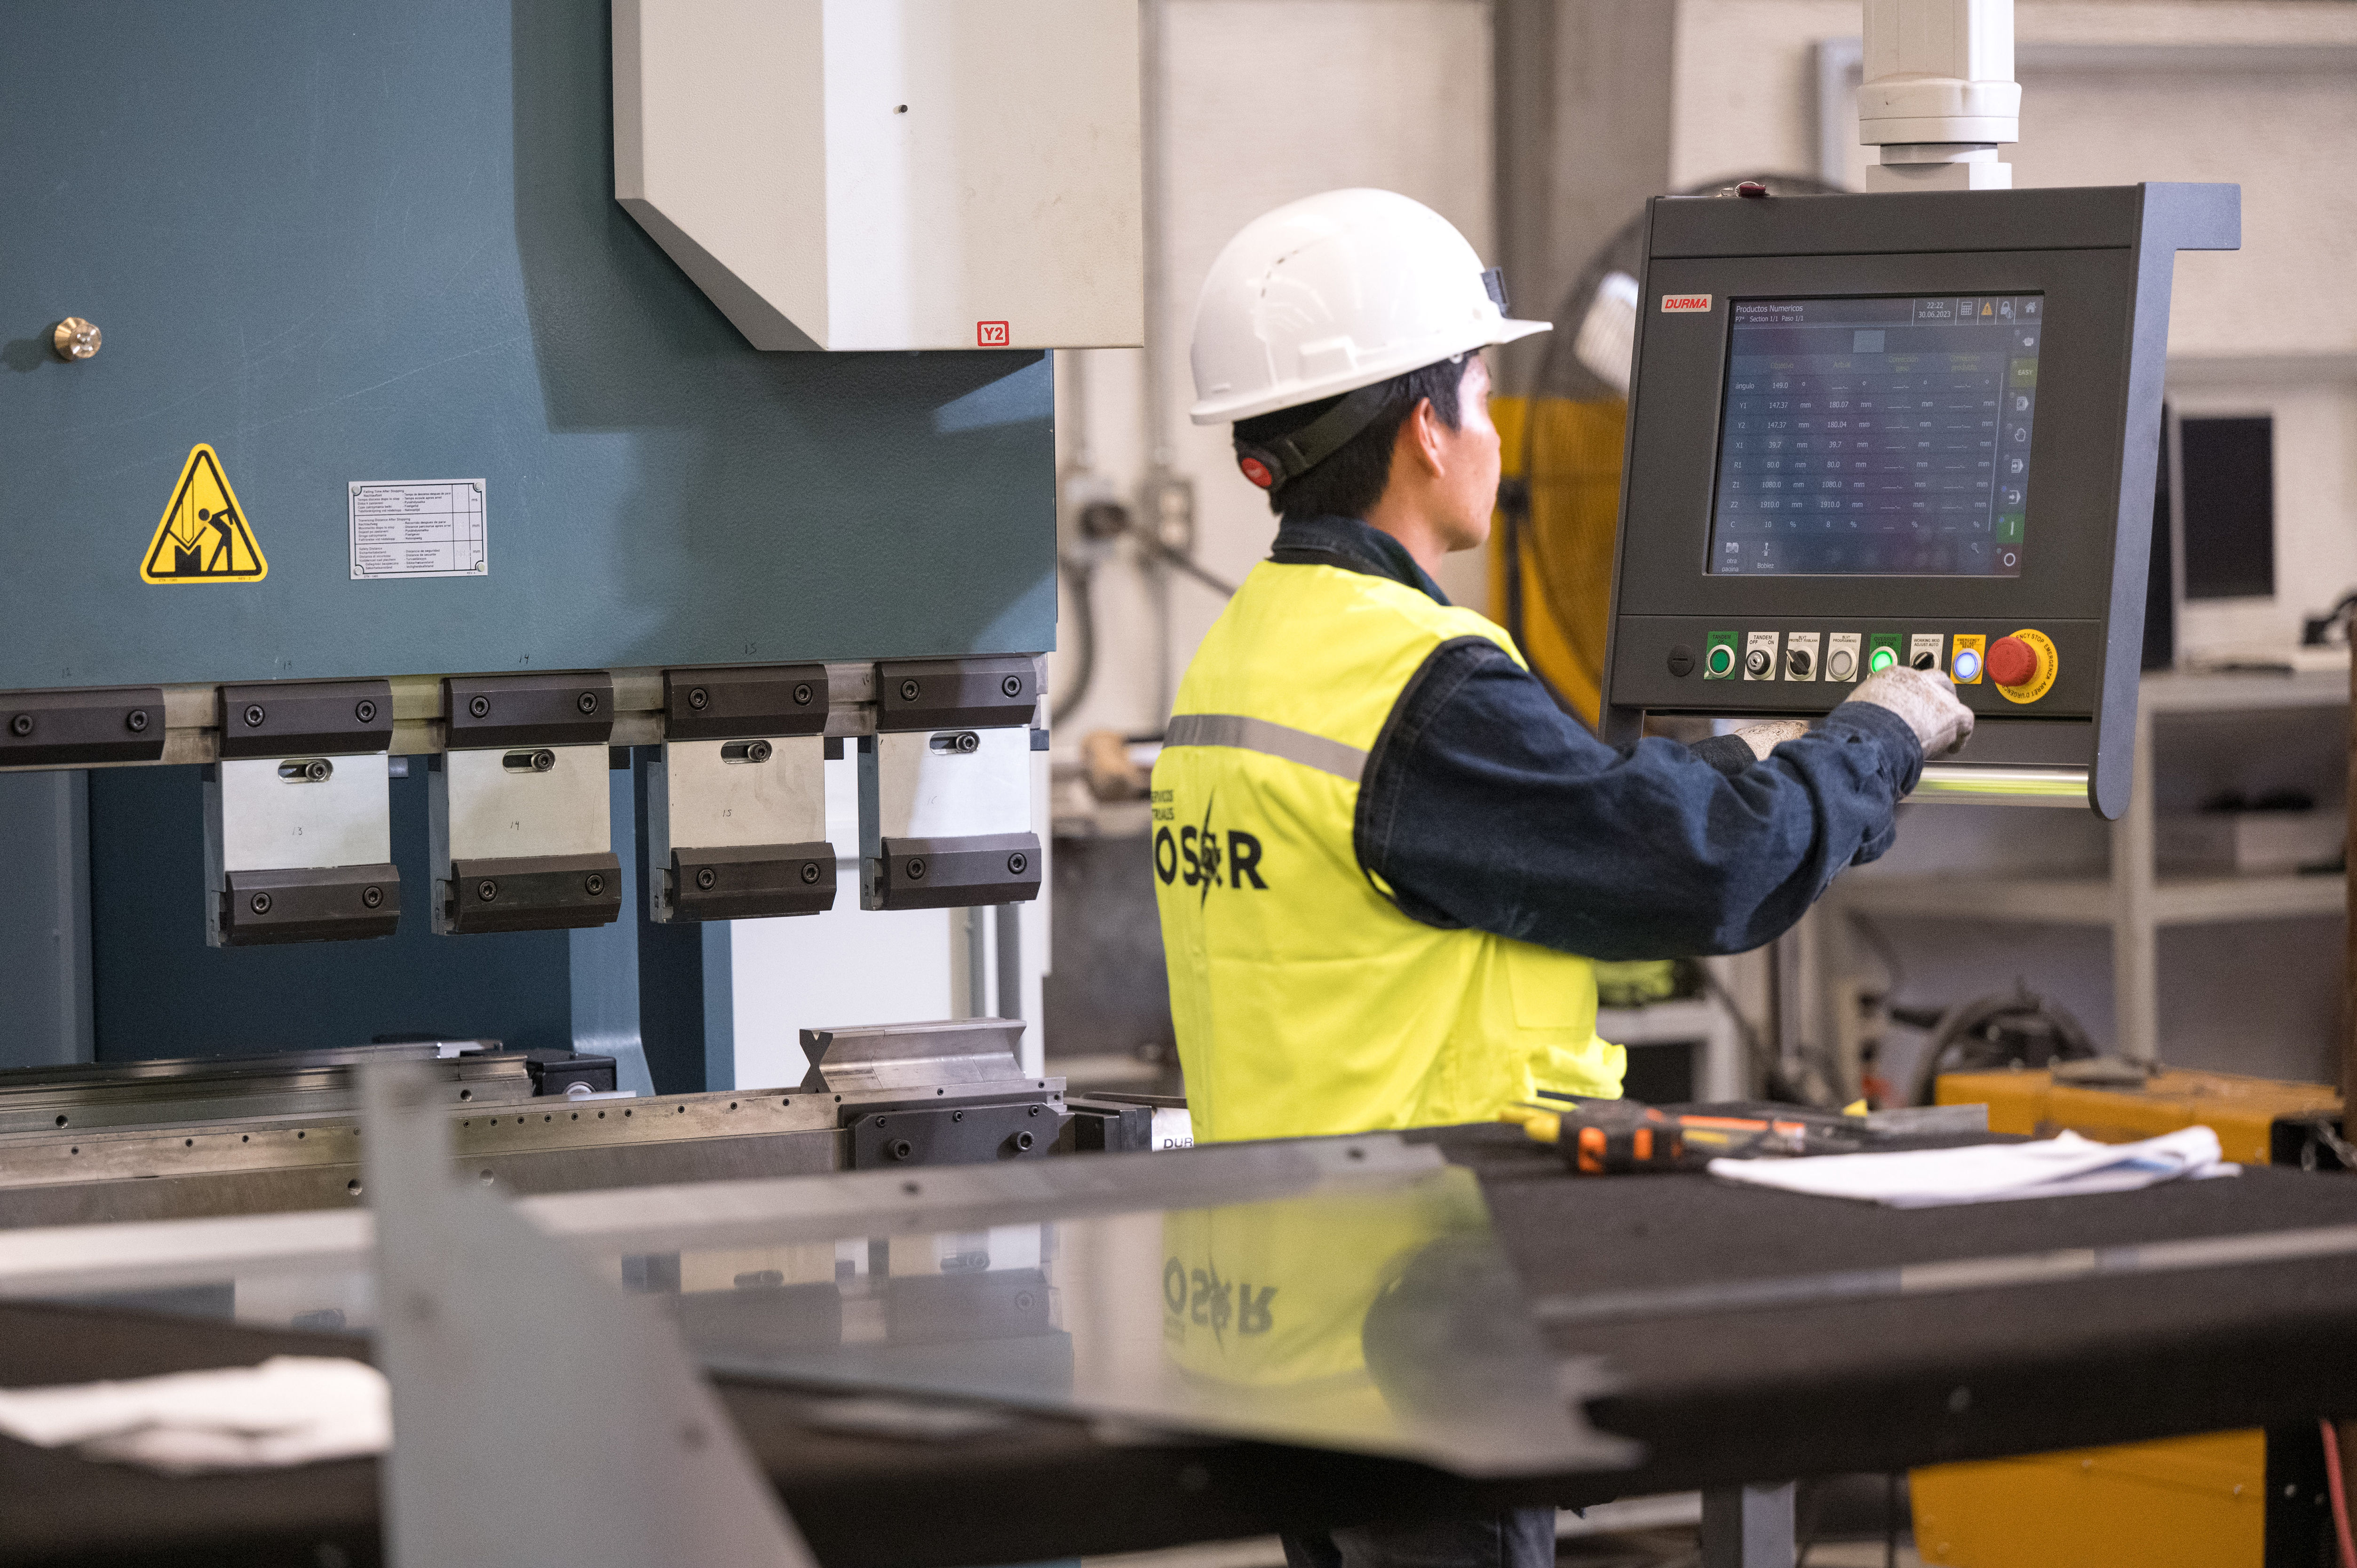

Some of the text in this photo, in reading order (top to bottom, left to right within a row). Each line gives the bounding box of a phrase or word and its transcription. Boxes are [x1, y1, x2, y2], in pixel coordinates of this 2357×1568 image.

[1665, 299, 1707, 309] DURMA
[984, 327, 1003, 340] Y2
[1735, 382, 1754, 390] ángulo
[2031, 634, 2044, 643] STOP
[745, 642, 757, 655] 15
[519, 654, 530, 665] 14
[2044, 643, 2054, 680] EMERGENZA
[292, 827, 303, 835] 13
[510, 821, 519, 831] 14
